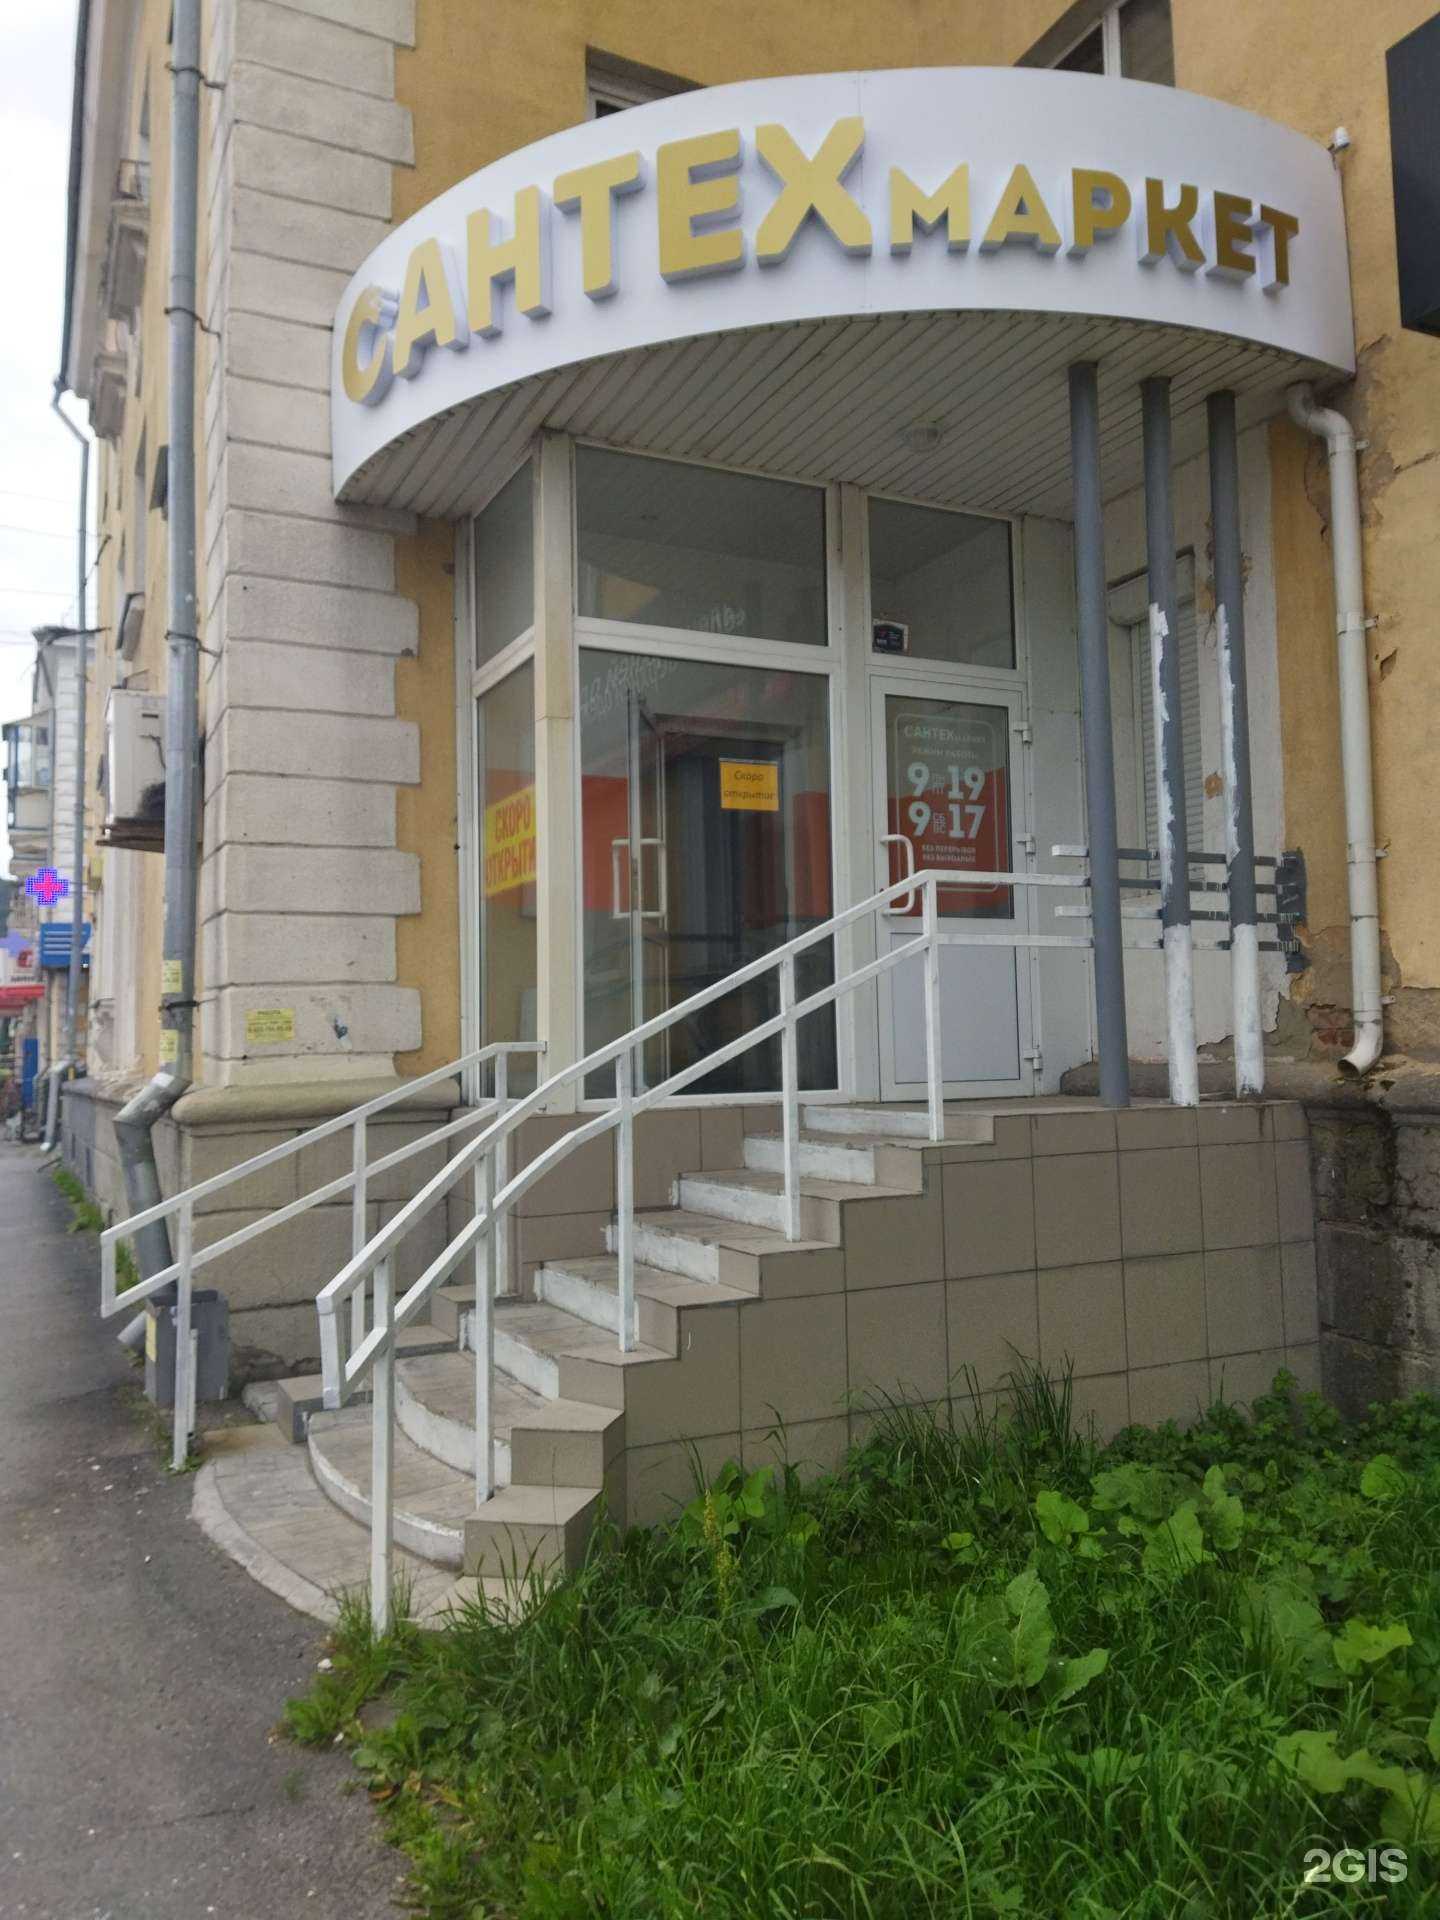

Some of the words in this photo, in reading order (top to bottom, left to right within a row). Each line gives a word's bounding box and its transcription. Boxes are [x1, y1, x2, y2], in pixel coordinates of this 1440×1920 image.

[907, 762, 930, 797] 9
[947, 765, 985, 801] 19
[495, 794, 531, 842] СКОРО
[908, 801, 931, 837] 9
[948, 804, 986, 839] 17
